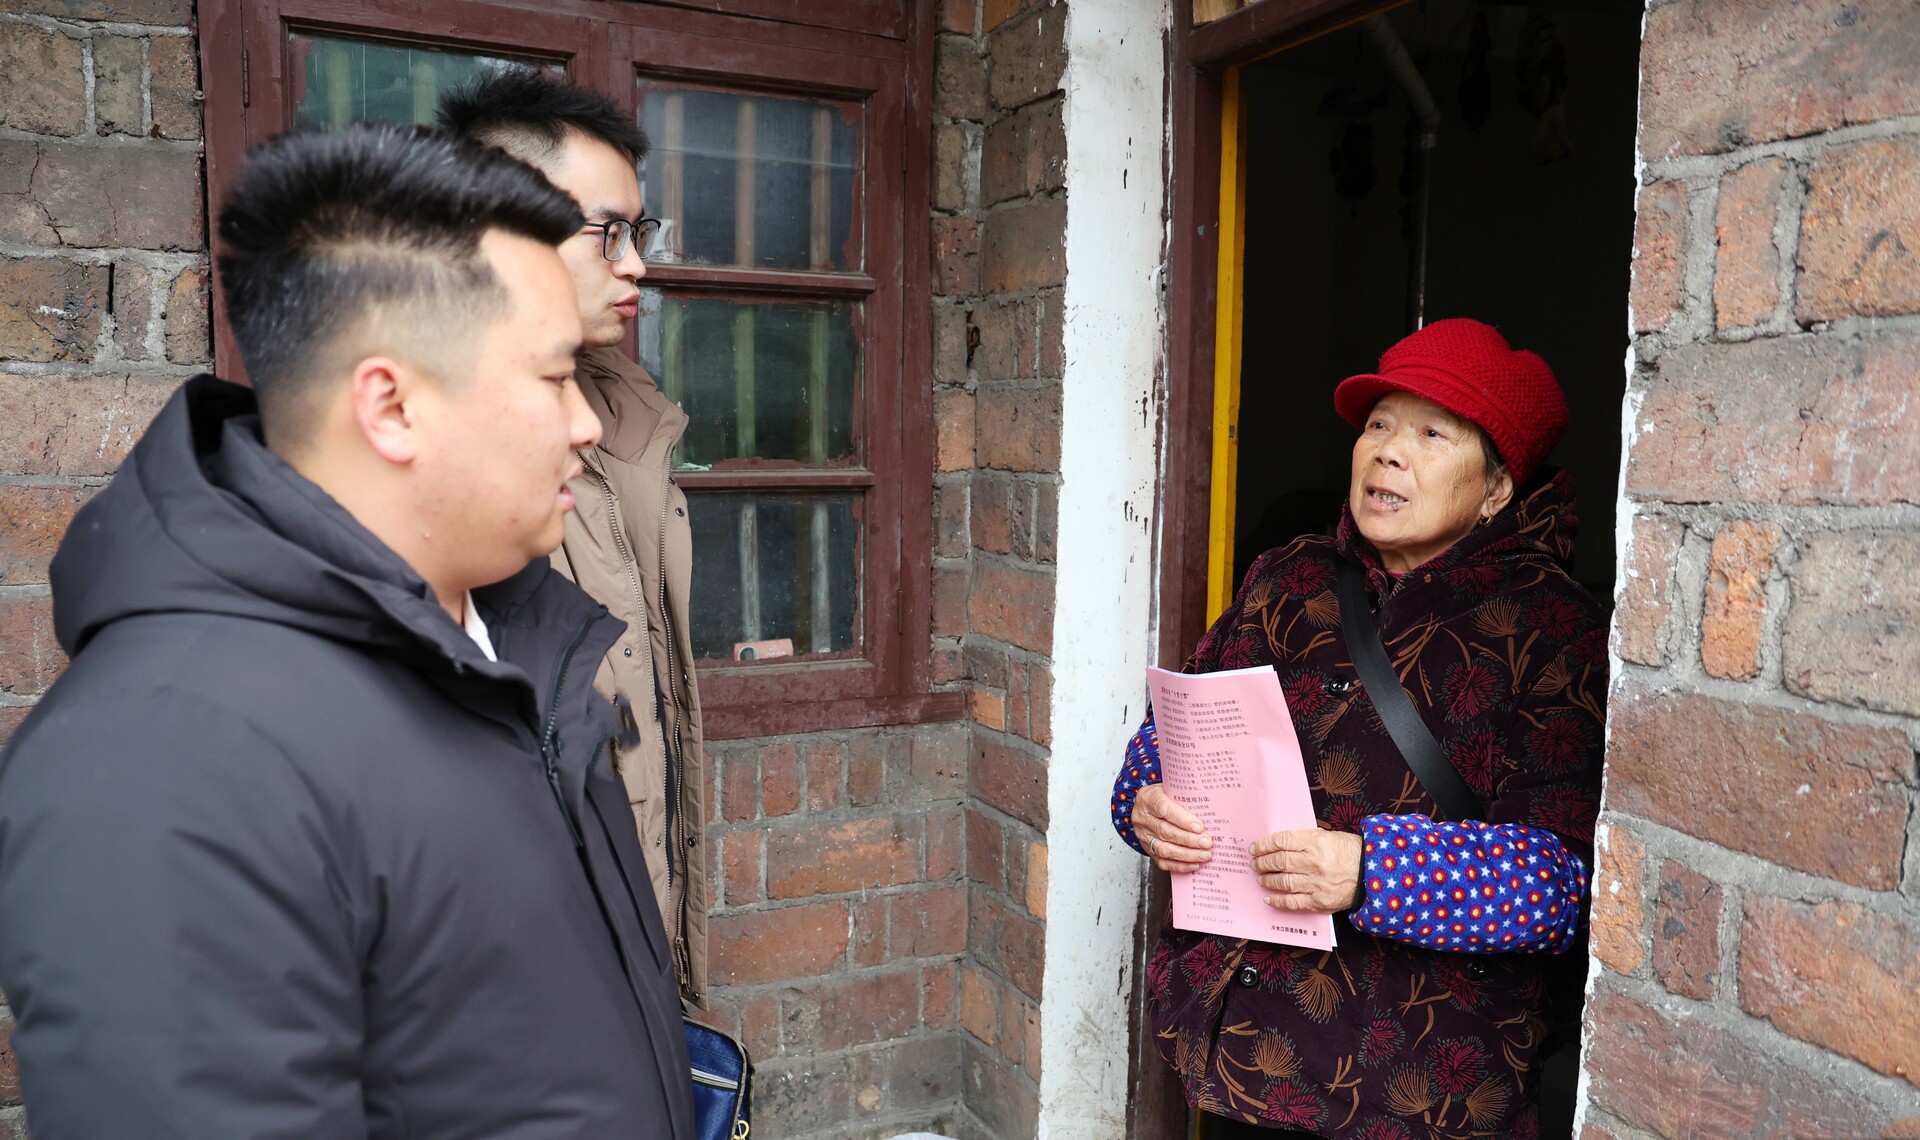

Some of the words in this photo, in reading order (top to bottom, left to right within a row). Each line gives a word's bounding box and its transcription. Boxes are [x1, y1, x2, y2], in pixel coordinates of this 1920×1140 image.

[1270, 924, 1308, 936] 冷水江街道办事处
